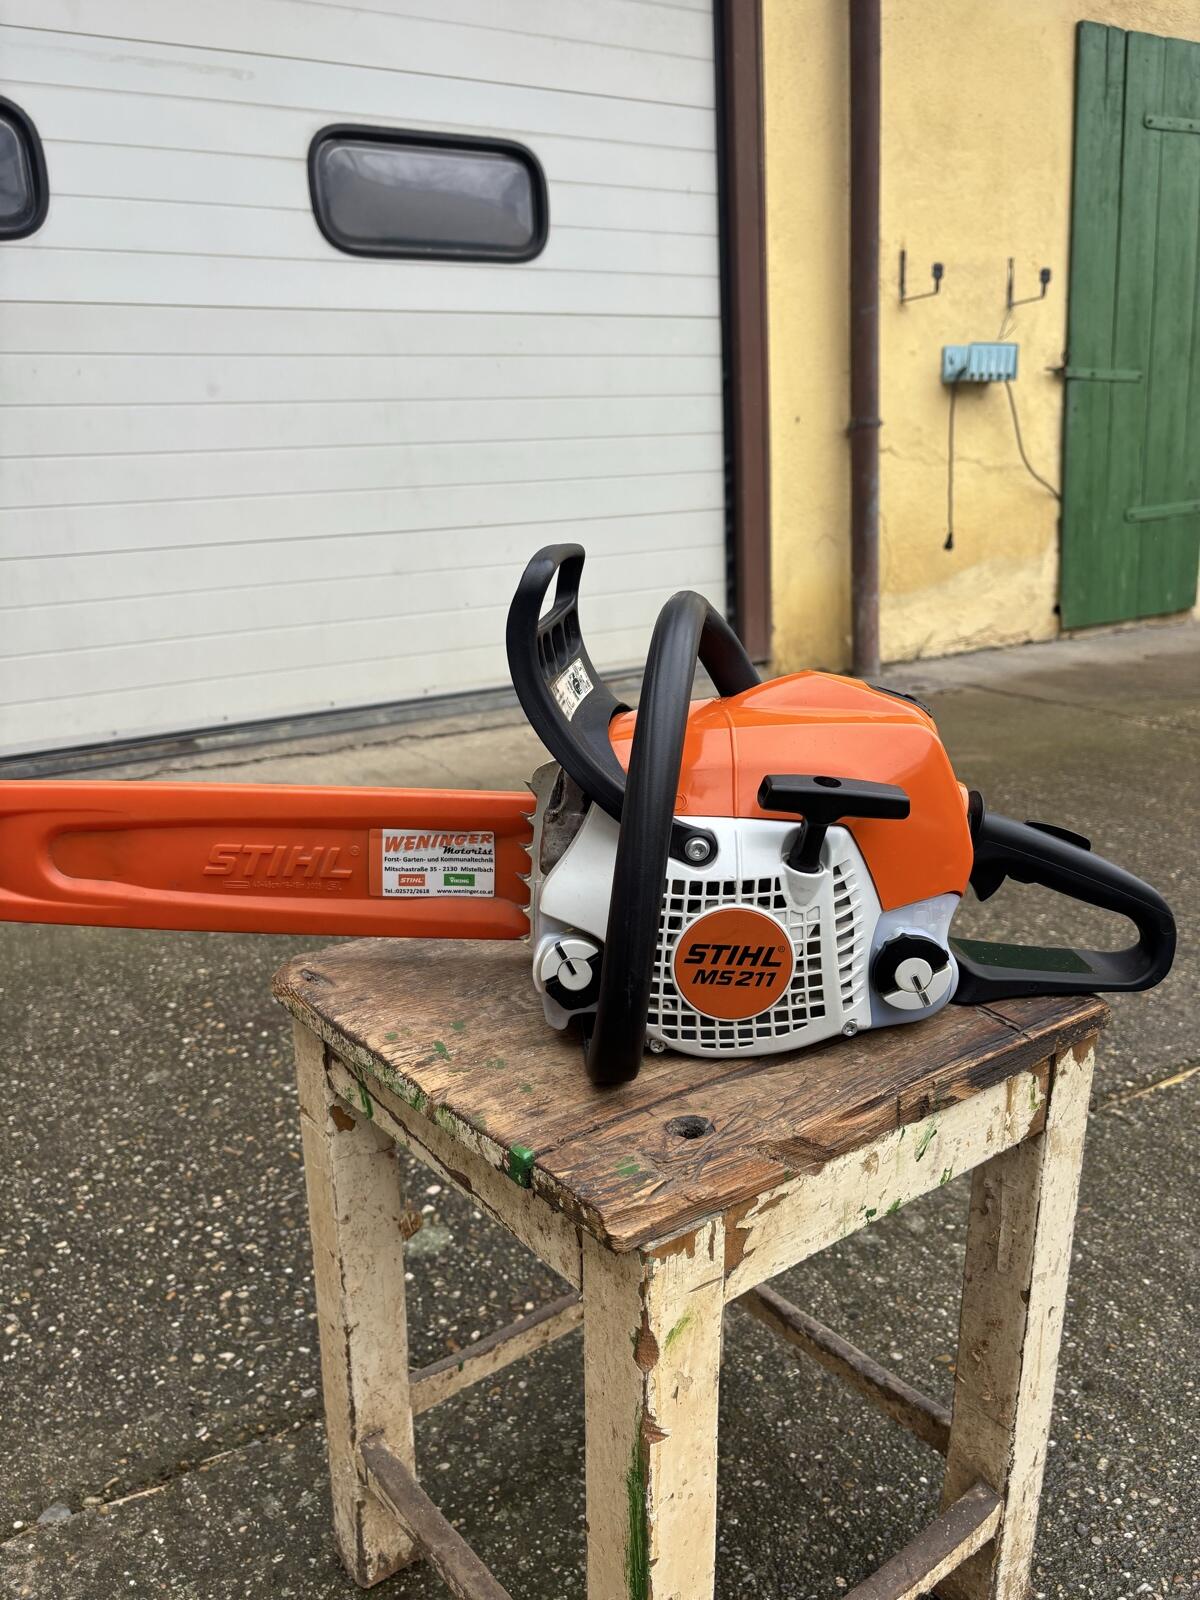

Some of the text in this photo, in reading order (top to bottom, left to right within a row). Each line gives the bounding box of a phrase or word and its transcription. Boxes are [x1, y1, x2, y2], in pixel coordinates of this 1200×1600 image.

[384, 834, 493, 853] WENINGER
[442, 846, 494, 855] Motorist
[203, 843, 353, 879] STIHL
[440, 856, 494, 864] Kommunaltechnik
[683, 943, 782, 967] STIHL
